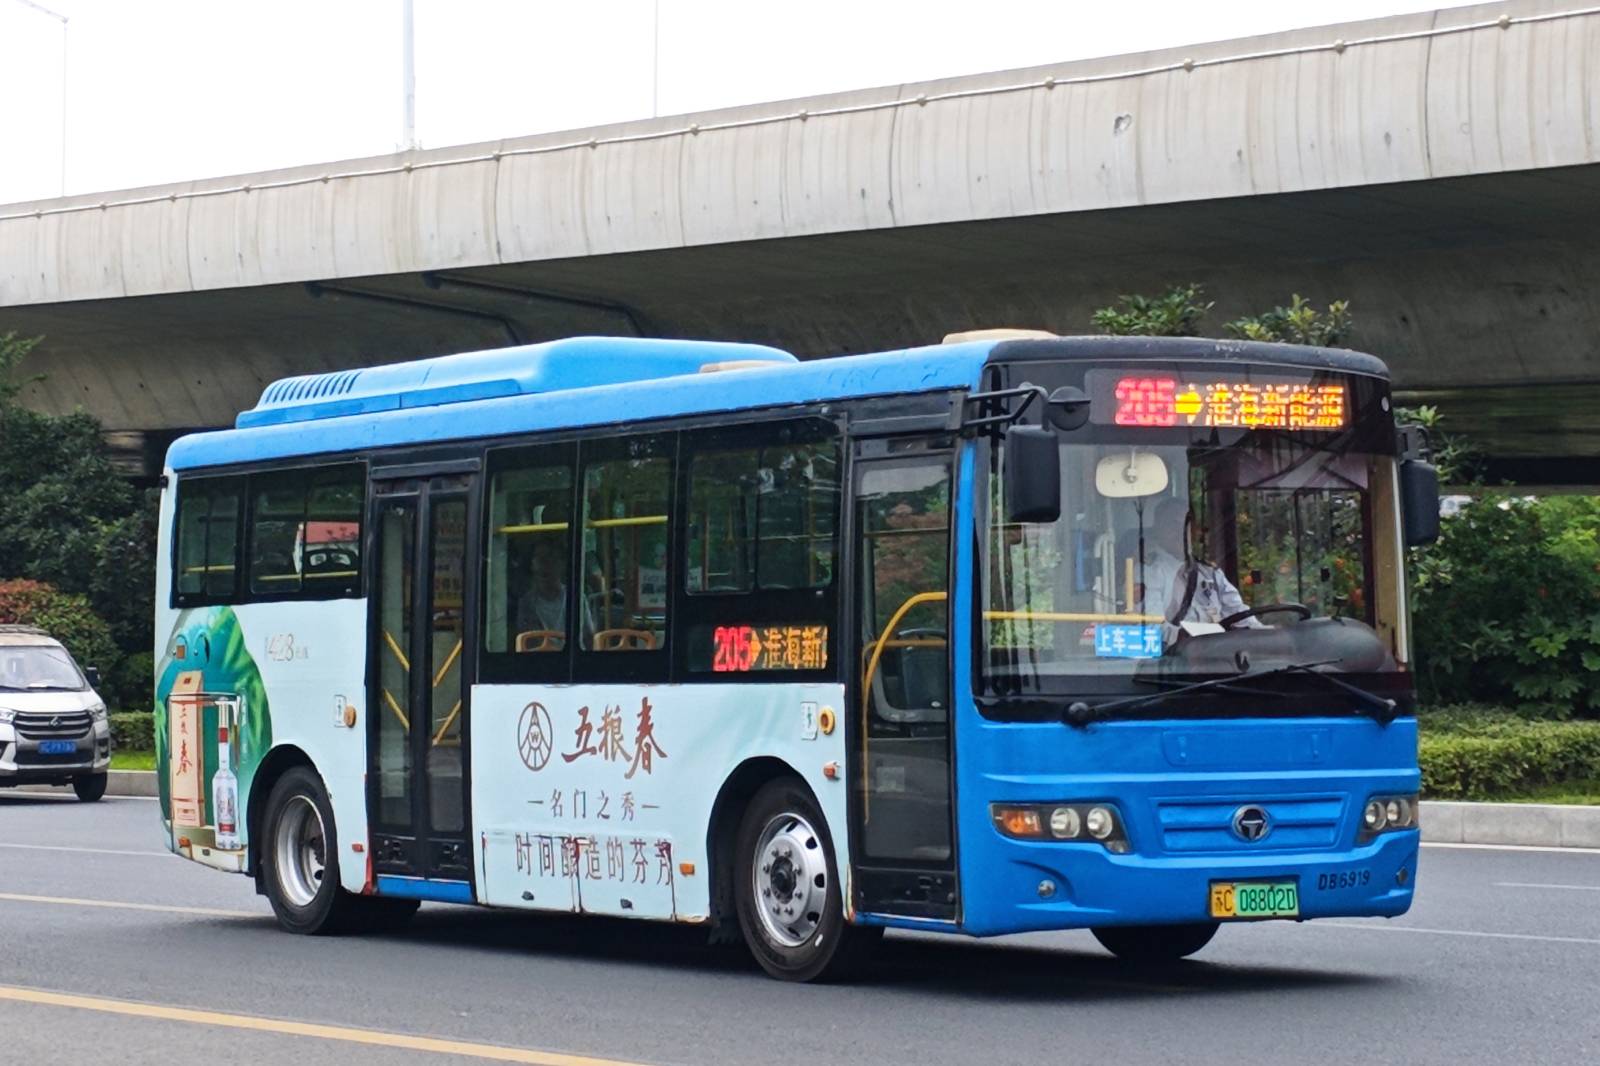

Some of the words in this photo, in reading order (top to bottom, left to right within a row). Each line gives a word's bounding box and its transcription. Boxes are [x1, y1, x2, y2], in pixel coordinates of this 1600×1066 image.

[713, 626, 751, 672] 205
[762, 626, 828, 670] 淮海新
[1097, 627, 1160, 654] 上车二元
[561, 696, 669, 780] 五粮春
[515, 831, 673, 887] 时间酿造的芬芳
[1317, 869, 1370, 891] DB6919
